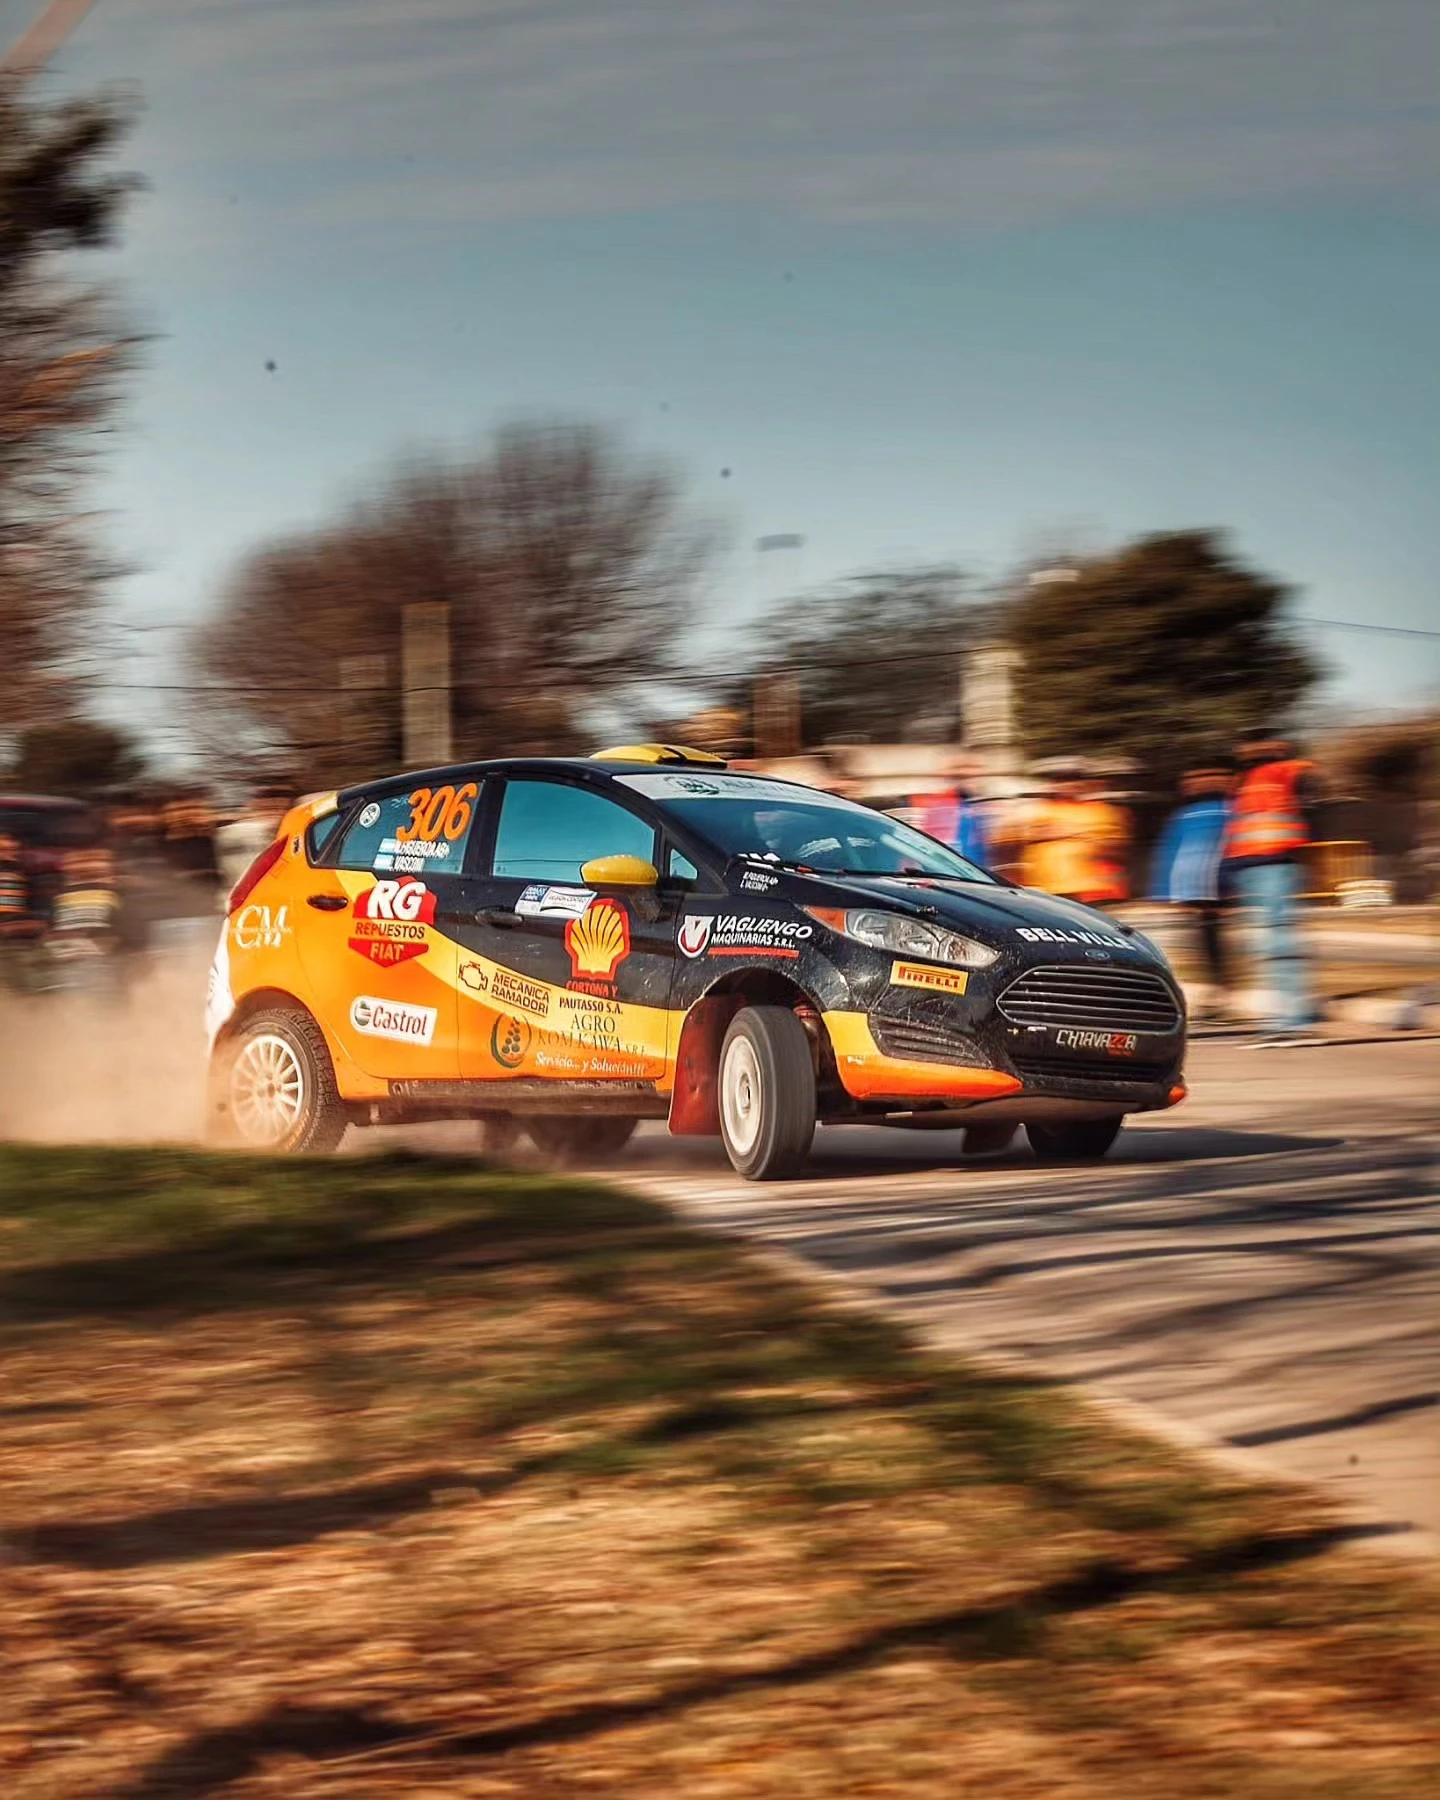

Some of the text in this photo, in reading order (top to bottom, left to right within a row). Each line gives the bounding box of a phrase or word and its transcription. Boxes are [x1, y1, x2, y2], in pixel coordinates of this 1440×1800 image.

[396, 783, 478, 841] 306
[367, 879, 427, 921] RG
[355, 922, 425, 939] REPUESTOS
[716, 915, 813, 939] VAGLIENGO
[370, 941, 404, 961] FIAT
[711, 933, 796, 949] MAQUINARIAS S.R.L.
[1015, 928, 1137, 951] BELL VILLE
[493, 972, 550, 1001] MECANICA
[565, 980, 619, 997] CORTONA Y
[899, 966, 960, 989] PIRELLI
[491, 985, 549, 1015] RAMADORI
[559, 996, 624, 1015] PAUTASSO S.A.
[373, 1005, 428, 1036] Castrol
[571, 1013, 616, 1034] AGRO
[1056, 1029, 1137, 1051] CHIAVAZZA
